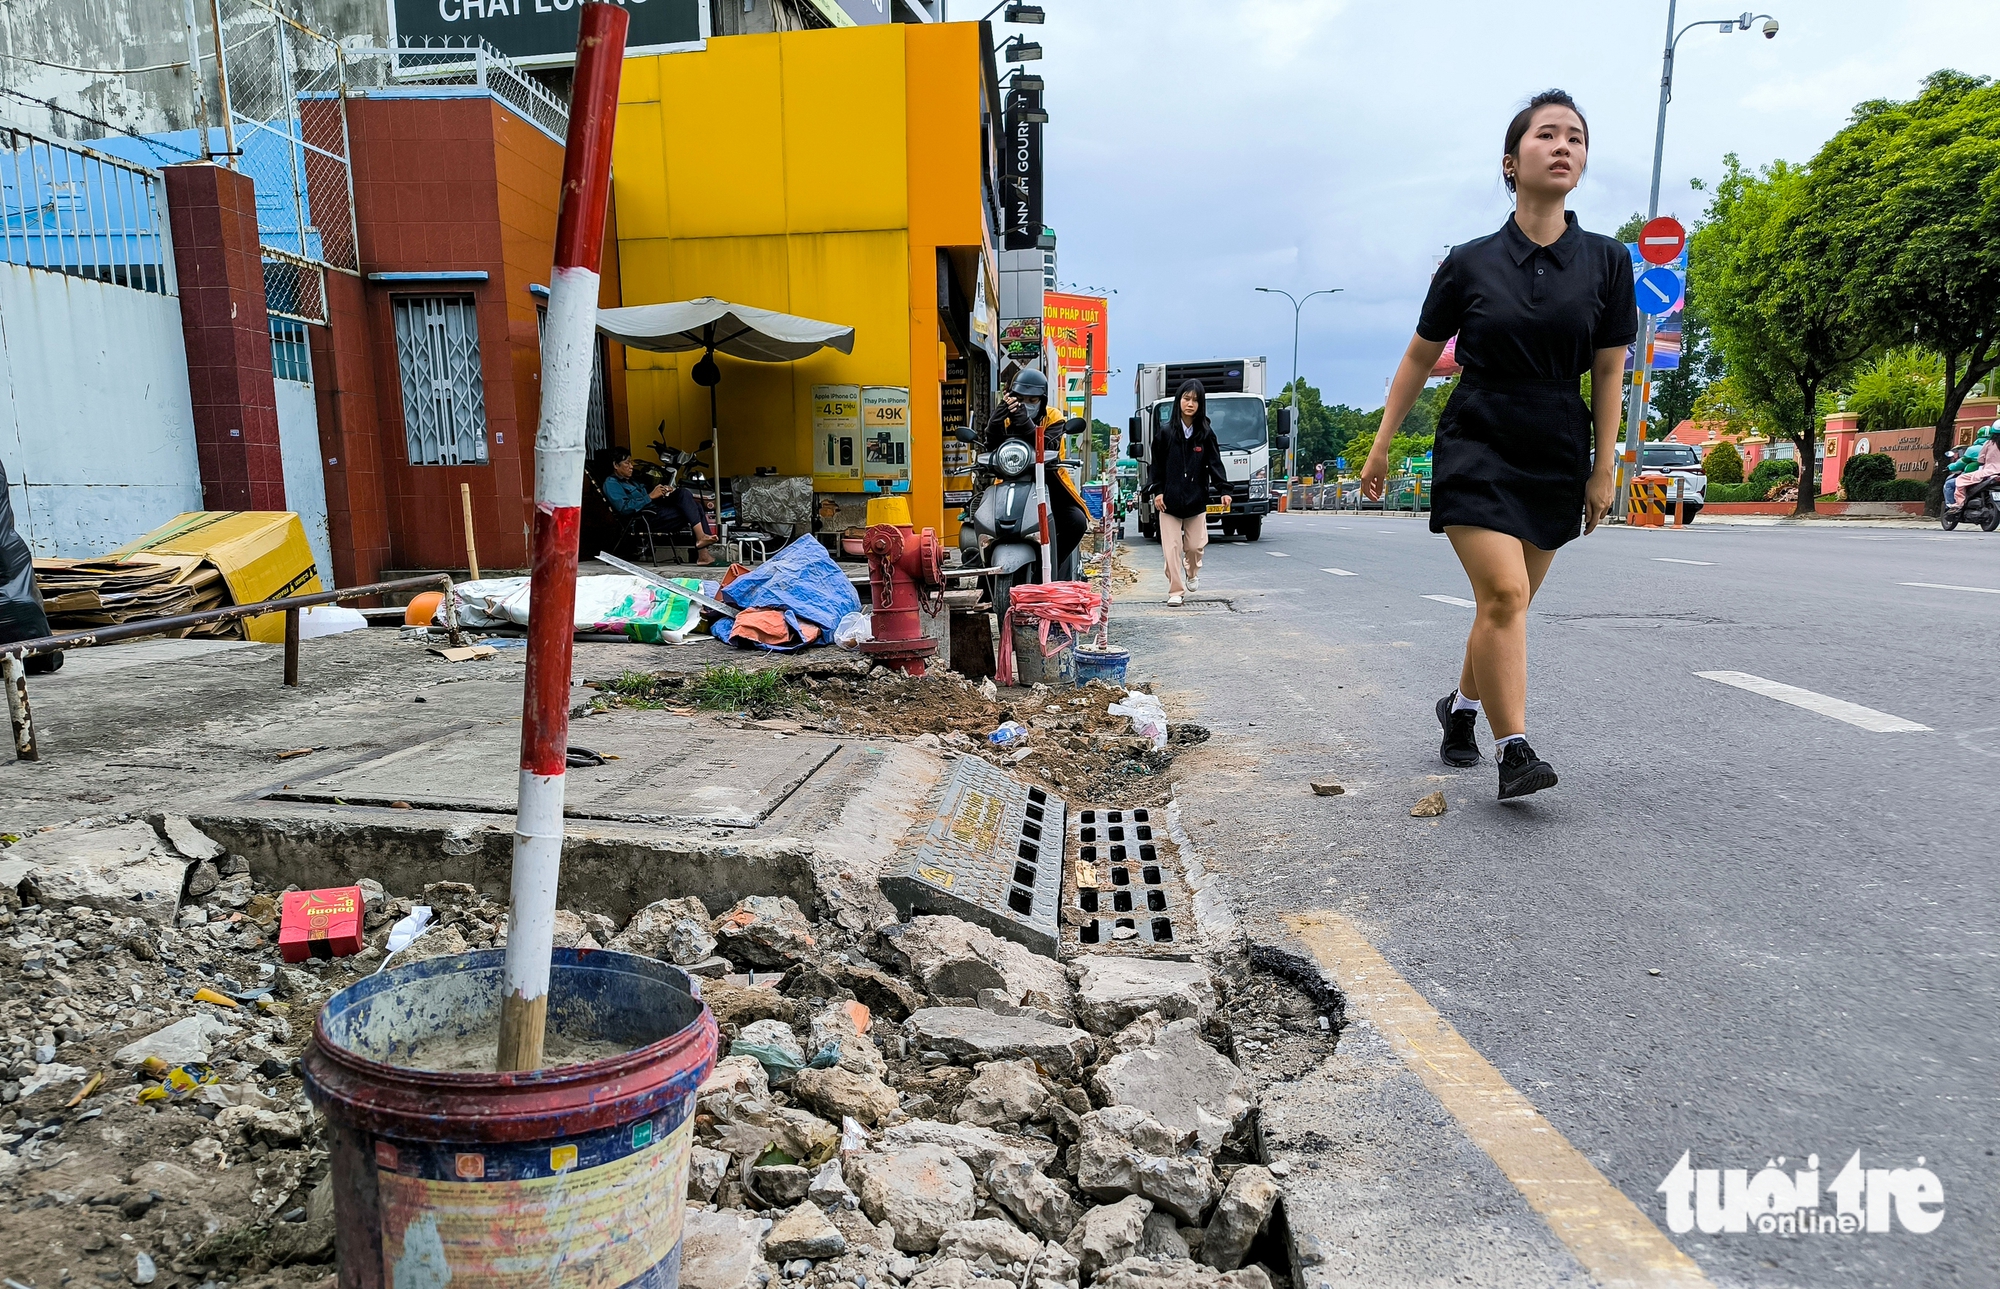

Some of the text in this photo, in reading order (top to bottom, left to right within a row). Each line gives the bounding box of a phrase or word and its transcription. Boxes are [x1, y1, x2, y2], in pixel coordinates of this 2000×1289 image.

[1017, 176, 1030, 235] ANNM
[1043, 303, 1099, 324] TÔN PHÁP LUẬT
[1068, 344, 1087, 359] THÔN
[864, 397, 877, 405] Thay
[823, 403, 843, 415] 4.5
[876, 407, 903, 420] 49K
[307, 906, 355, 916] Oolong
